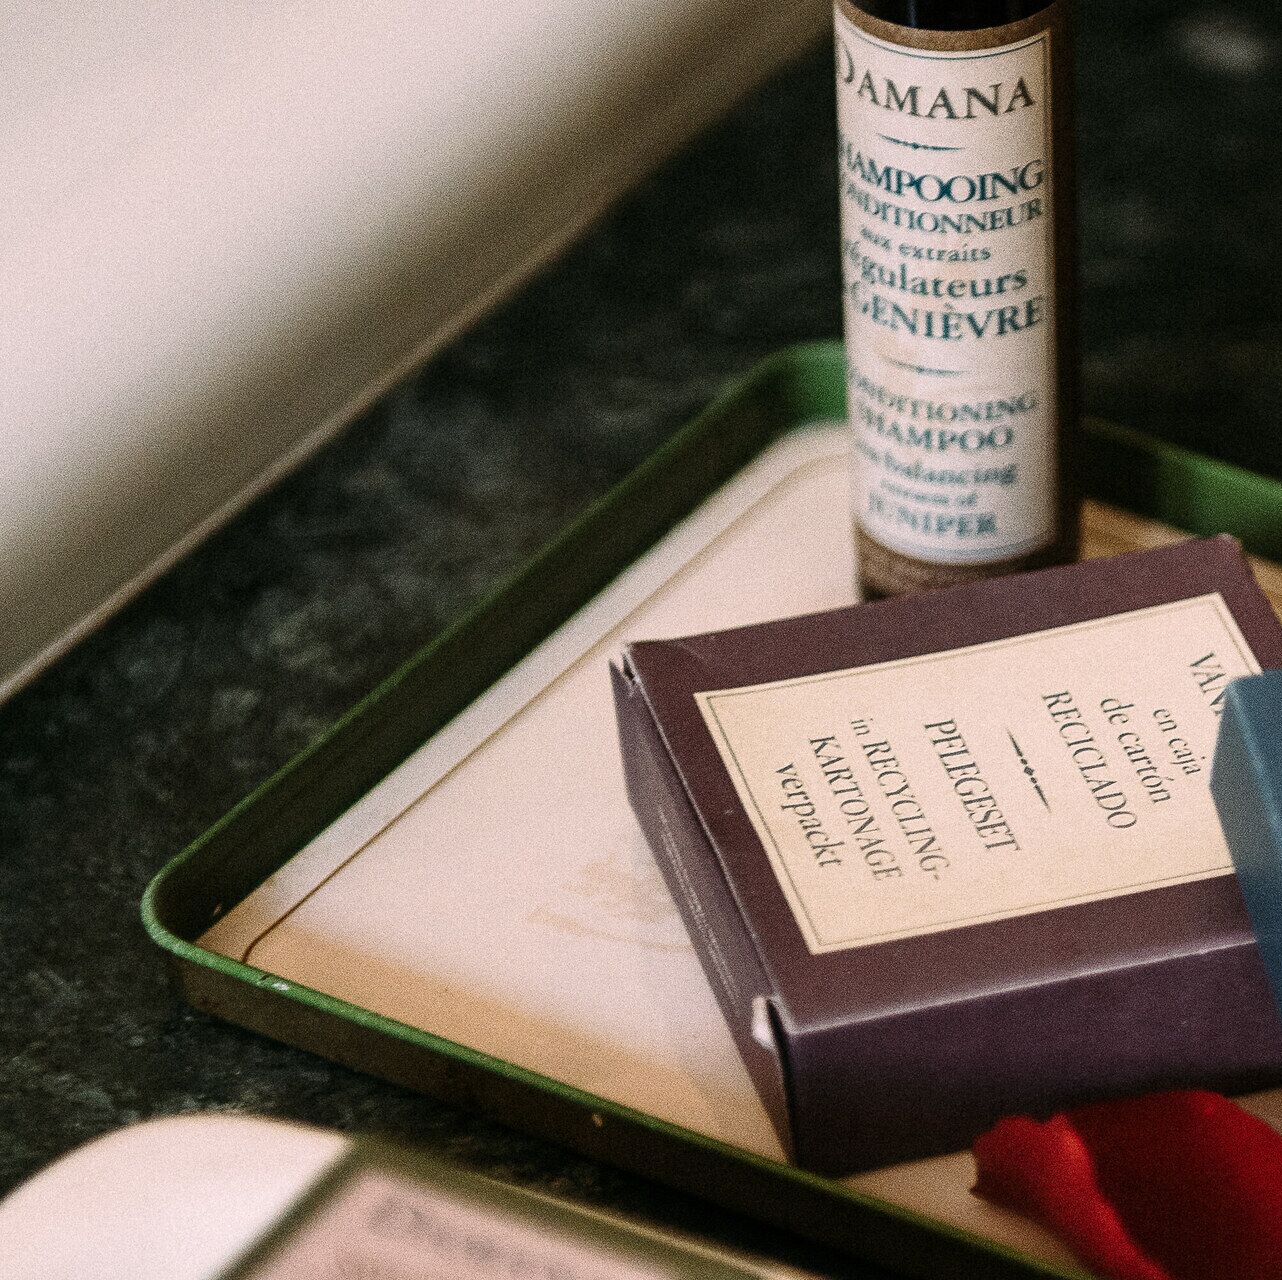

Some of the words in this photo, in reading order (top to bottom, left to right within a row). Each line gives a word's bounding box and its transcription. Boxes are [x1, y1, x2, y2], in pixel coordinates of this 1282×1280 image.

[840, 140, 1048, 203] AMPOOING
[898, 241, 992, 262] extraits
[1100, 696, 1135, 726] de
[1189, 651, 1228, 718] VAN
[1042, 689, 1138, 830] RECICLADO
[1117, 731, 1175, 804] cartón
[1152, 707, 1178, 733] en
[1168, 735, 1207, 776] caja
[774, 761, 845, 868] verpackt
[808, 734, 902, 881] KARTONAGE
[924, 718, 1021, 851] PFLEGESET
